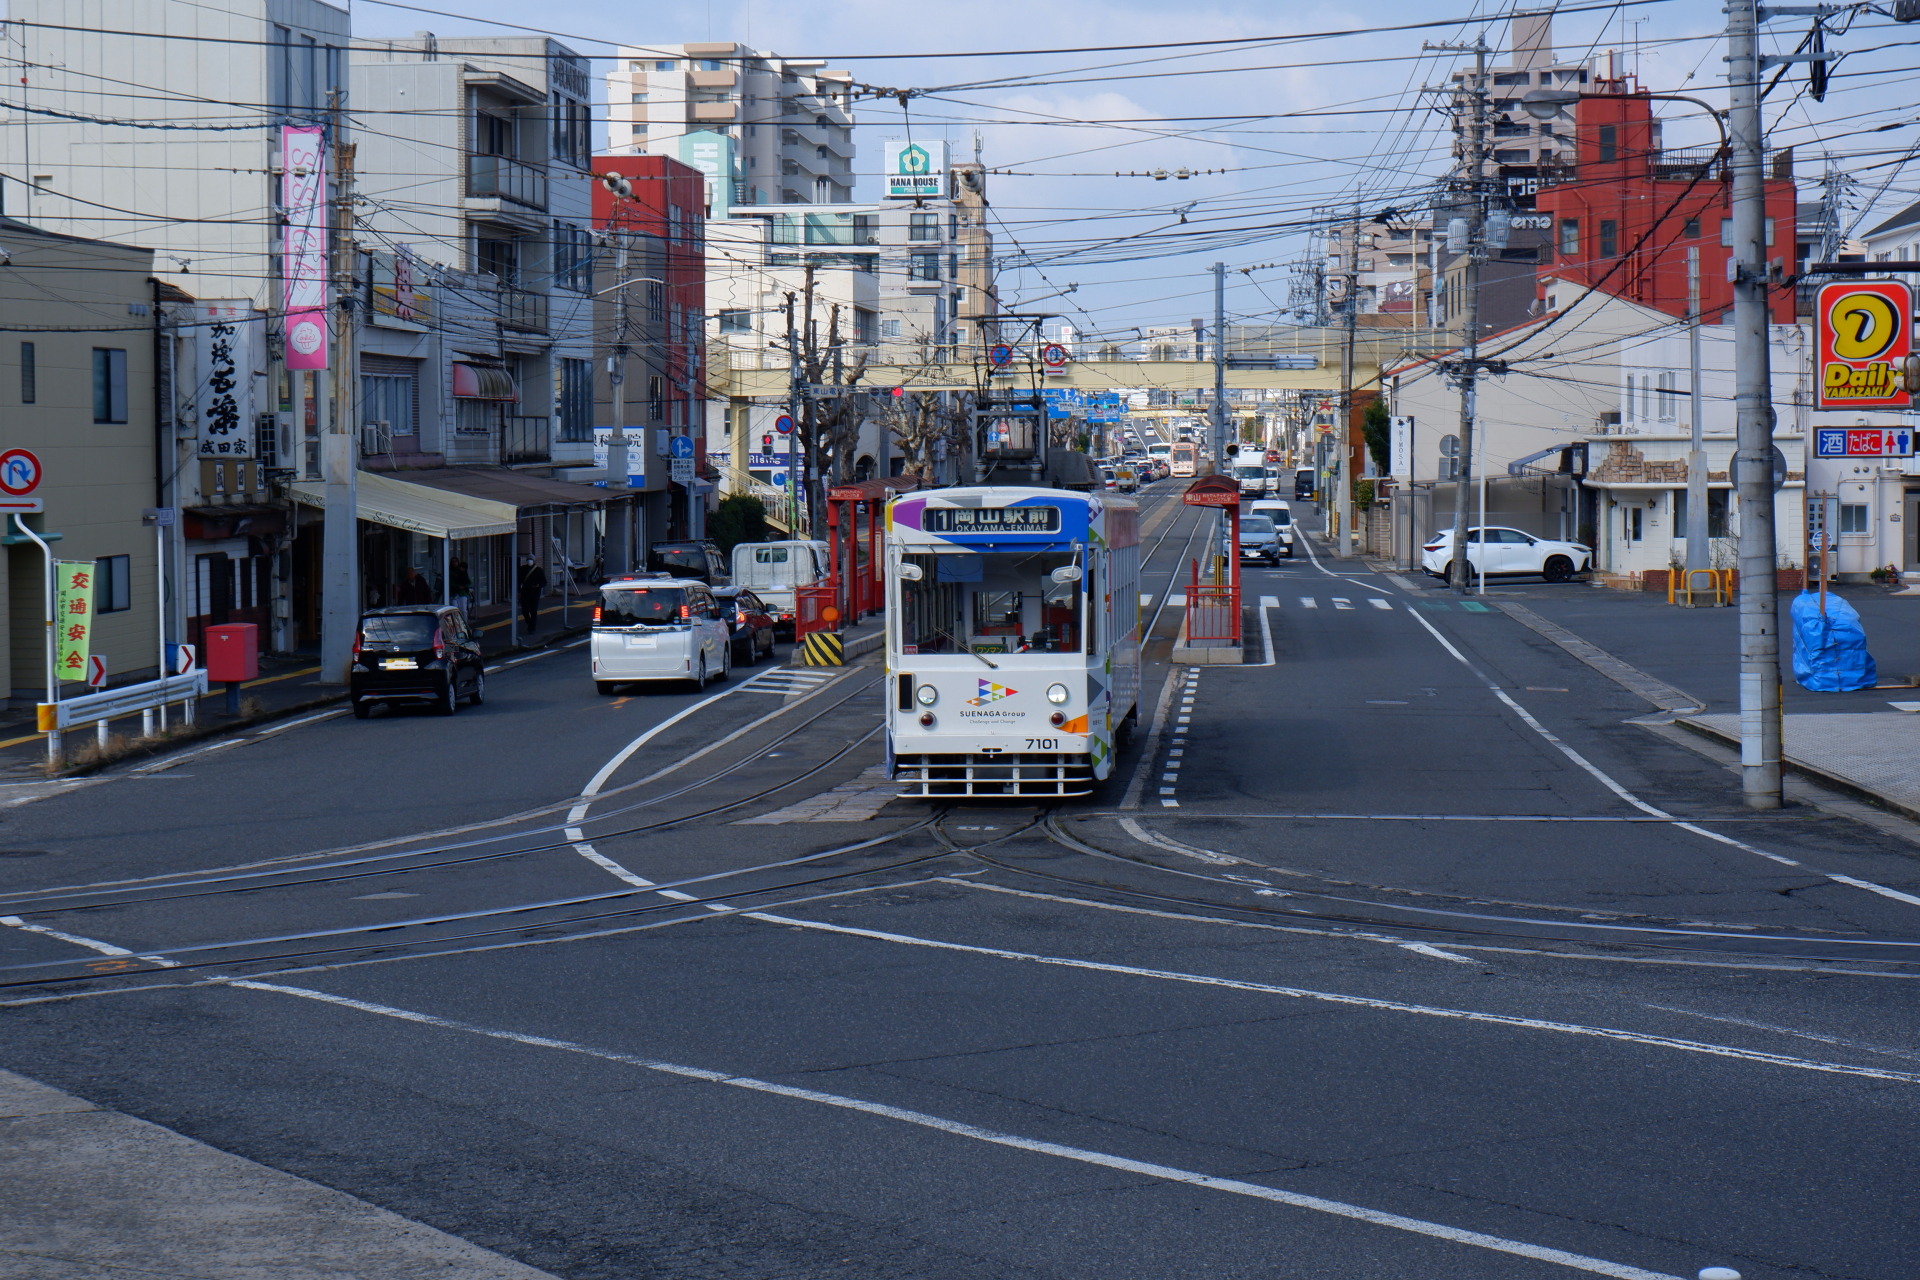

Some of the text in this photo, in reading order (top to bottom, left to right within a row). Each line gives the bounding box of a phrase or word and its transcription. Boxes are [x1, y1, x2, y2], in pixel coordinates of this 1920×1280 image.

[890, 178, 938, 186] HANA HOUSE
[292, 229, 318, 291] Cake
[1824, 361, 1906, 397] Daily
[1824, 386, 1884, 398] YAMAZAKI
[200, 438, 247, 455] 成田家
[1823, 433, 1880, 453] 酒 たばこ
[749, 455, 782, 464] Rising
[1186, 494, 1200, 502] 東山
[373, 512, 399, 526] SaSa
[938, 510, 948, 530] 1
[954, 509, 1049, 524] 岡山駅前
[65, 572, 90, 669] 交通安全
[1026, 739, 1058, 750] 7101
